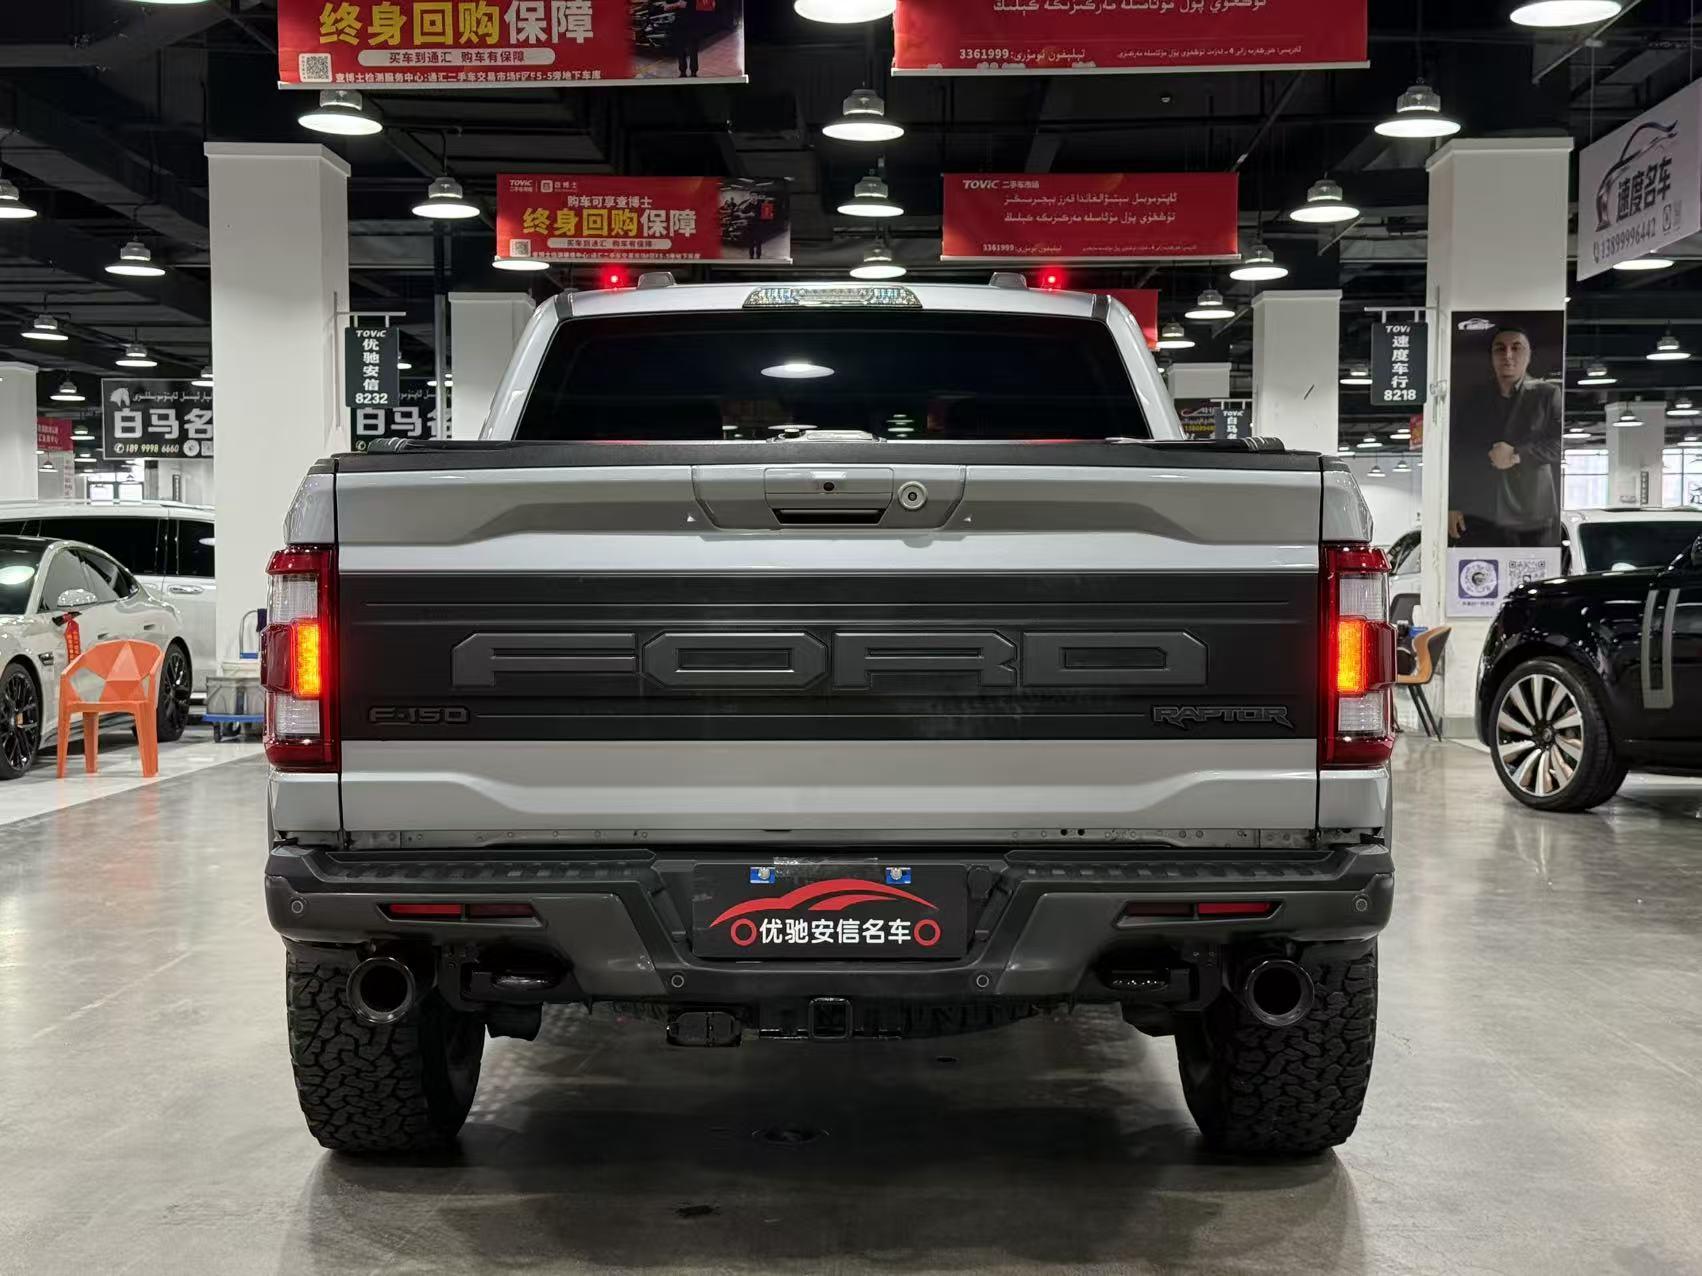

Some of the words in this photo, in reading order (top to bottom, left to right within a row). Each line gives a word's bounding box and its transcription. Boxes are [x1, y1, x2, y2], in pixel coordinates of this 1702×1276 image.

[319, 0, 594, 45] 终身回购保障
[389, 52, 452, 64] 买车到通汇
[461, 51, 525, 63] 购车有保障
[959, 49, 1009, 60] 3361999
[1616, 156, 1672, 223] 速度名车
[522, 207, 696, 237] 终身回购保障
[363, 339, 379, 391] 优驰安信
[1391, 335, 1409, 388] 速度车行
[355, 393, 388, 404] 8232
[1383, 389, 1416, 401] 8218
[451, 630, 1208, 689] FORD
[368, 705, 470, 725] F-150
[1151, 704, 1294, 730] RAPTOR
[759, 918, 911, 944] 优驰安信名车
